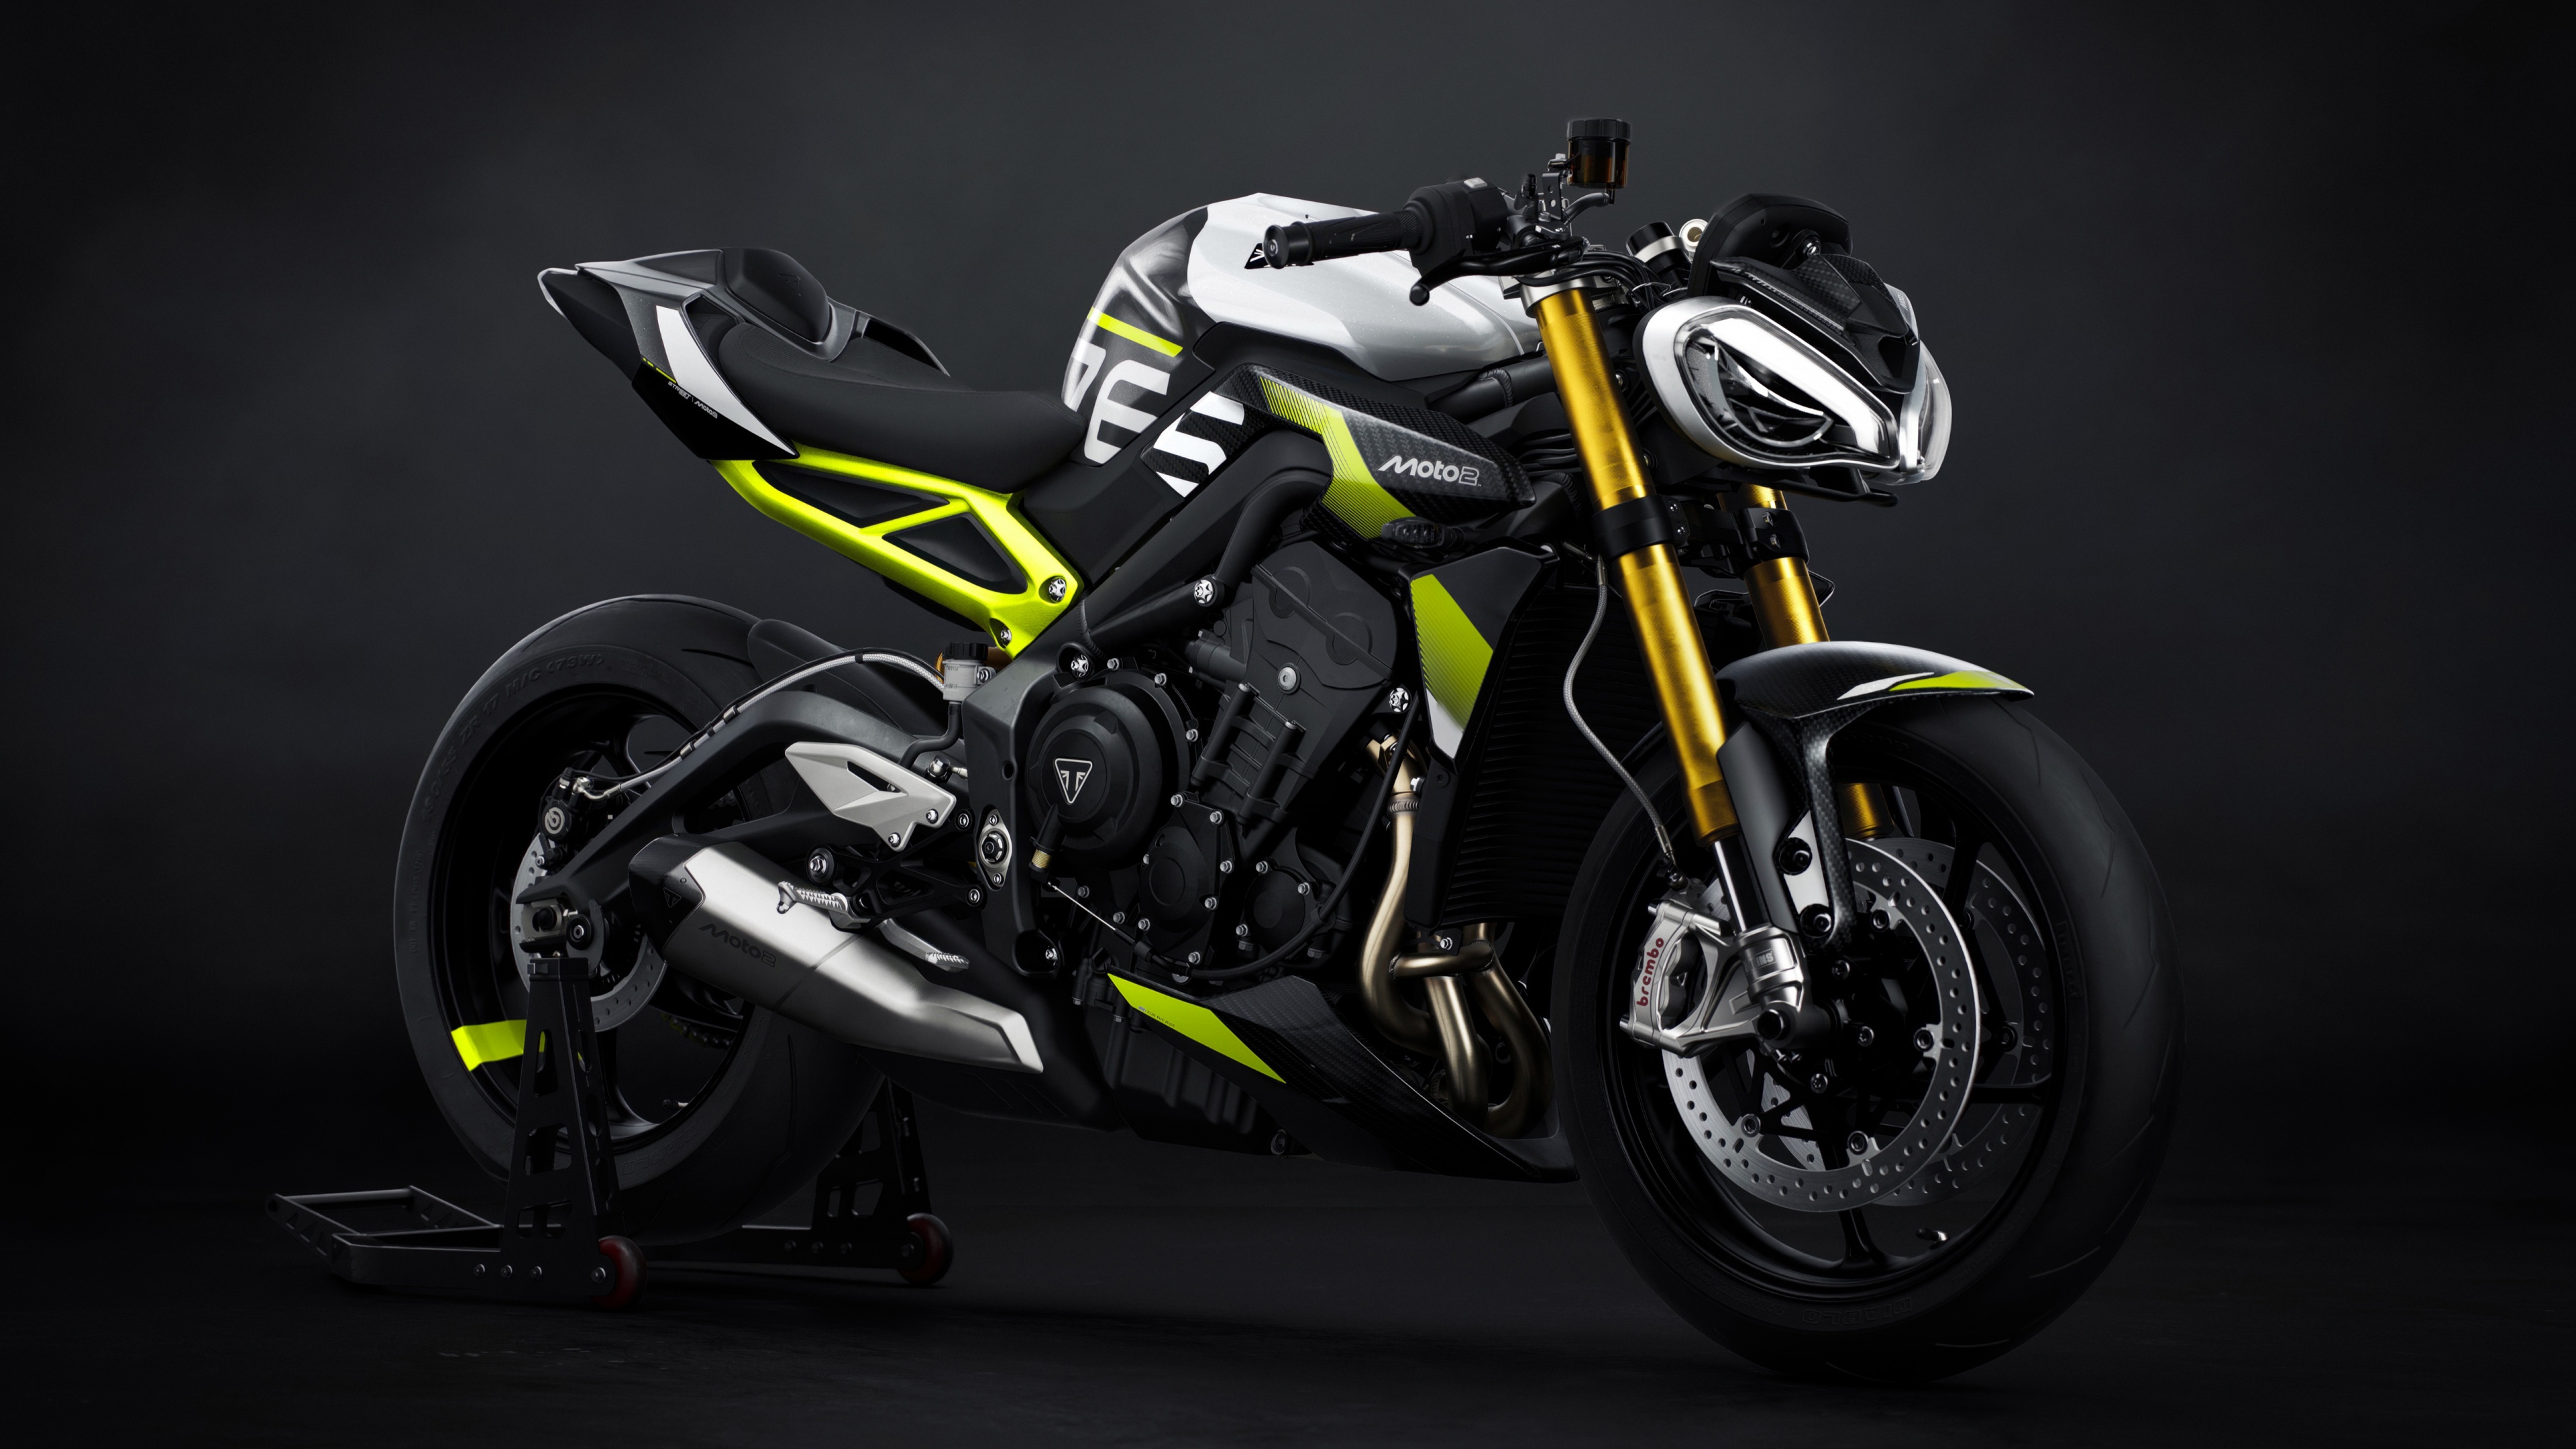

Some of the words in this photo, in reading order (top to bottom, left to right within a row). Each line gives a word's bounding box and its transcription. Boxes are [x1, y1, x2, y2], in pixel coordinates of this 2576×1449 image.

[694, 400, 718, 419] Moto2
[1377, 455, 1480, 486] Moto2
[505, 667, 541, 698] M/C
[699, 923, 777, 968] Moto2
[1635, 937, 1665, 1007] brembo
[1801, 1296, 1912, 1326] DIABLO
